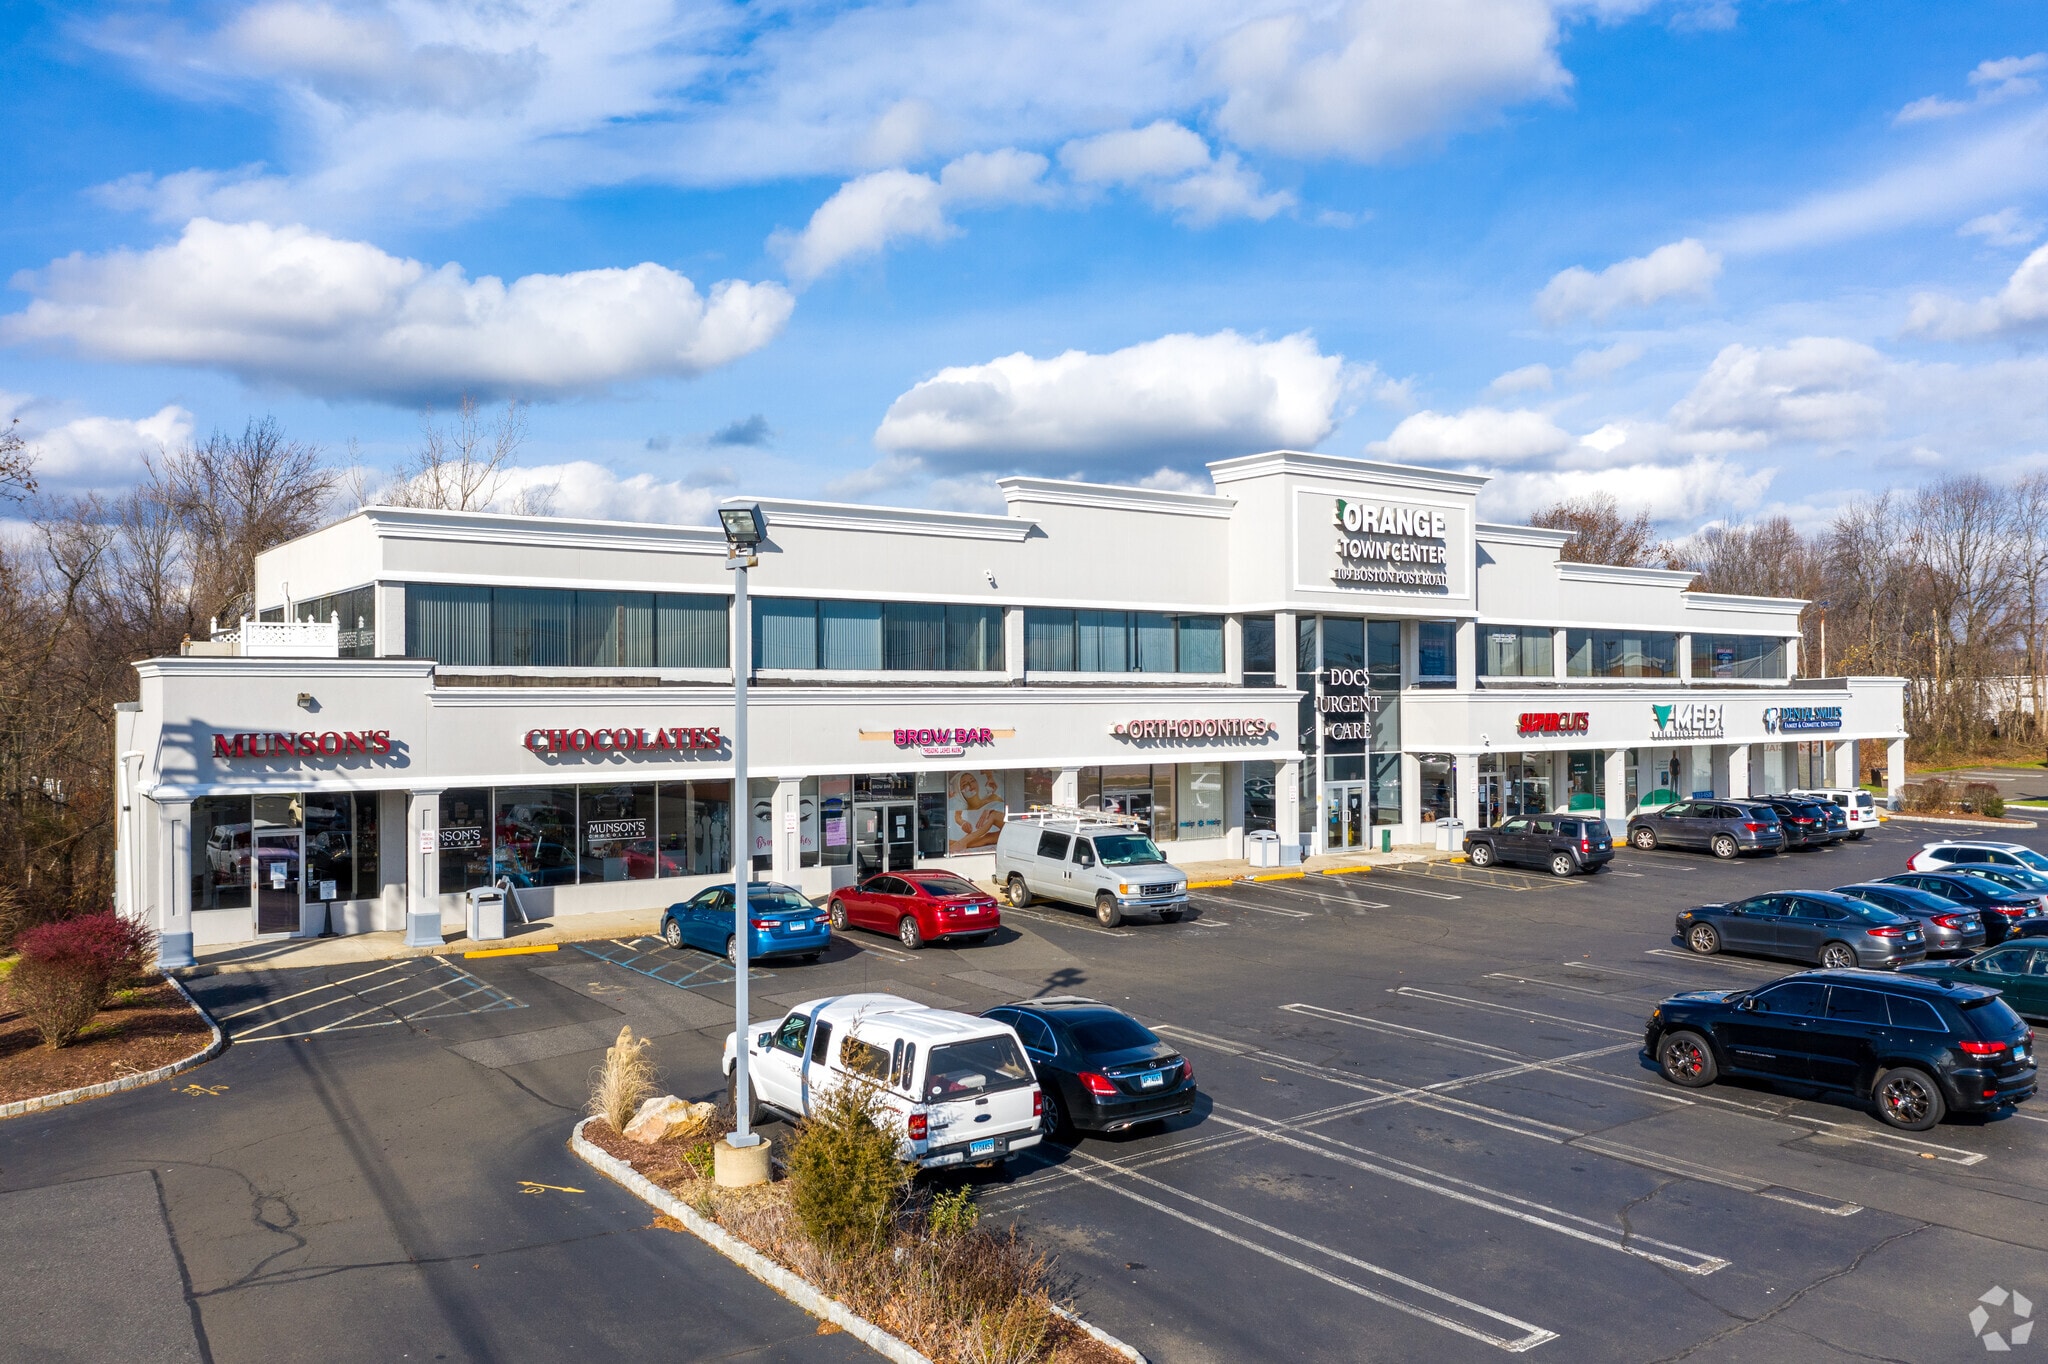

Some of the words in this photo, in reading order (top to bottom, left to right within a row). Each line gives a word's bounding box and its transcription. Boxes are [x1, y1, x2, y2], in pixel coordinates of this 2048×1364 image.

[1343, 503, 1445, 538] ORANGE
[1341, 539, 1387, 560] TOWN
[1391, 543, 1446, 563] CENTER
[1337, 568, 1351, 580] 109
[1354, 570, 1394, 583] BOSTON
[1396, 573, 1421, 584] POST
[1423, 574, 1448, 585] ROAD
[1330, 668, 1370, 686] DOCS
[1318, 695, 1381, 713] URGENT
[1782, 707, 1813, 720] DENTAL
[1816, 706, 1842, 719] SMILES
[1520, 712, 1589, 732] SUPERCUTS
[1675, 704, 1724, 729] MEDI
[894, 728, 950, 745] BROW
[955, 727, 992, 744] BAR
[1129, 718, 1266, 738] ORTHODONTICS
[1332, 722, 1372, 740] CARE
[212, 730, 391, 758] MUNSON'S
[524, 727, 720, 752] CHOCOLATES
[440, 829, 481, 841] NSON'S
[589, 821, 645, 833] MUNSON'S
